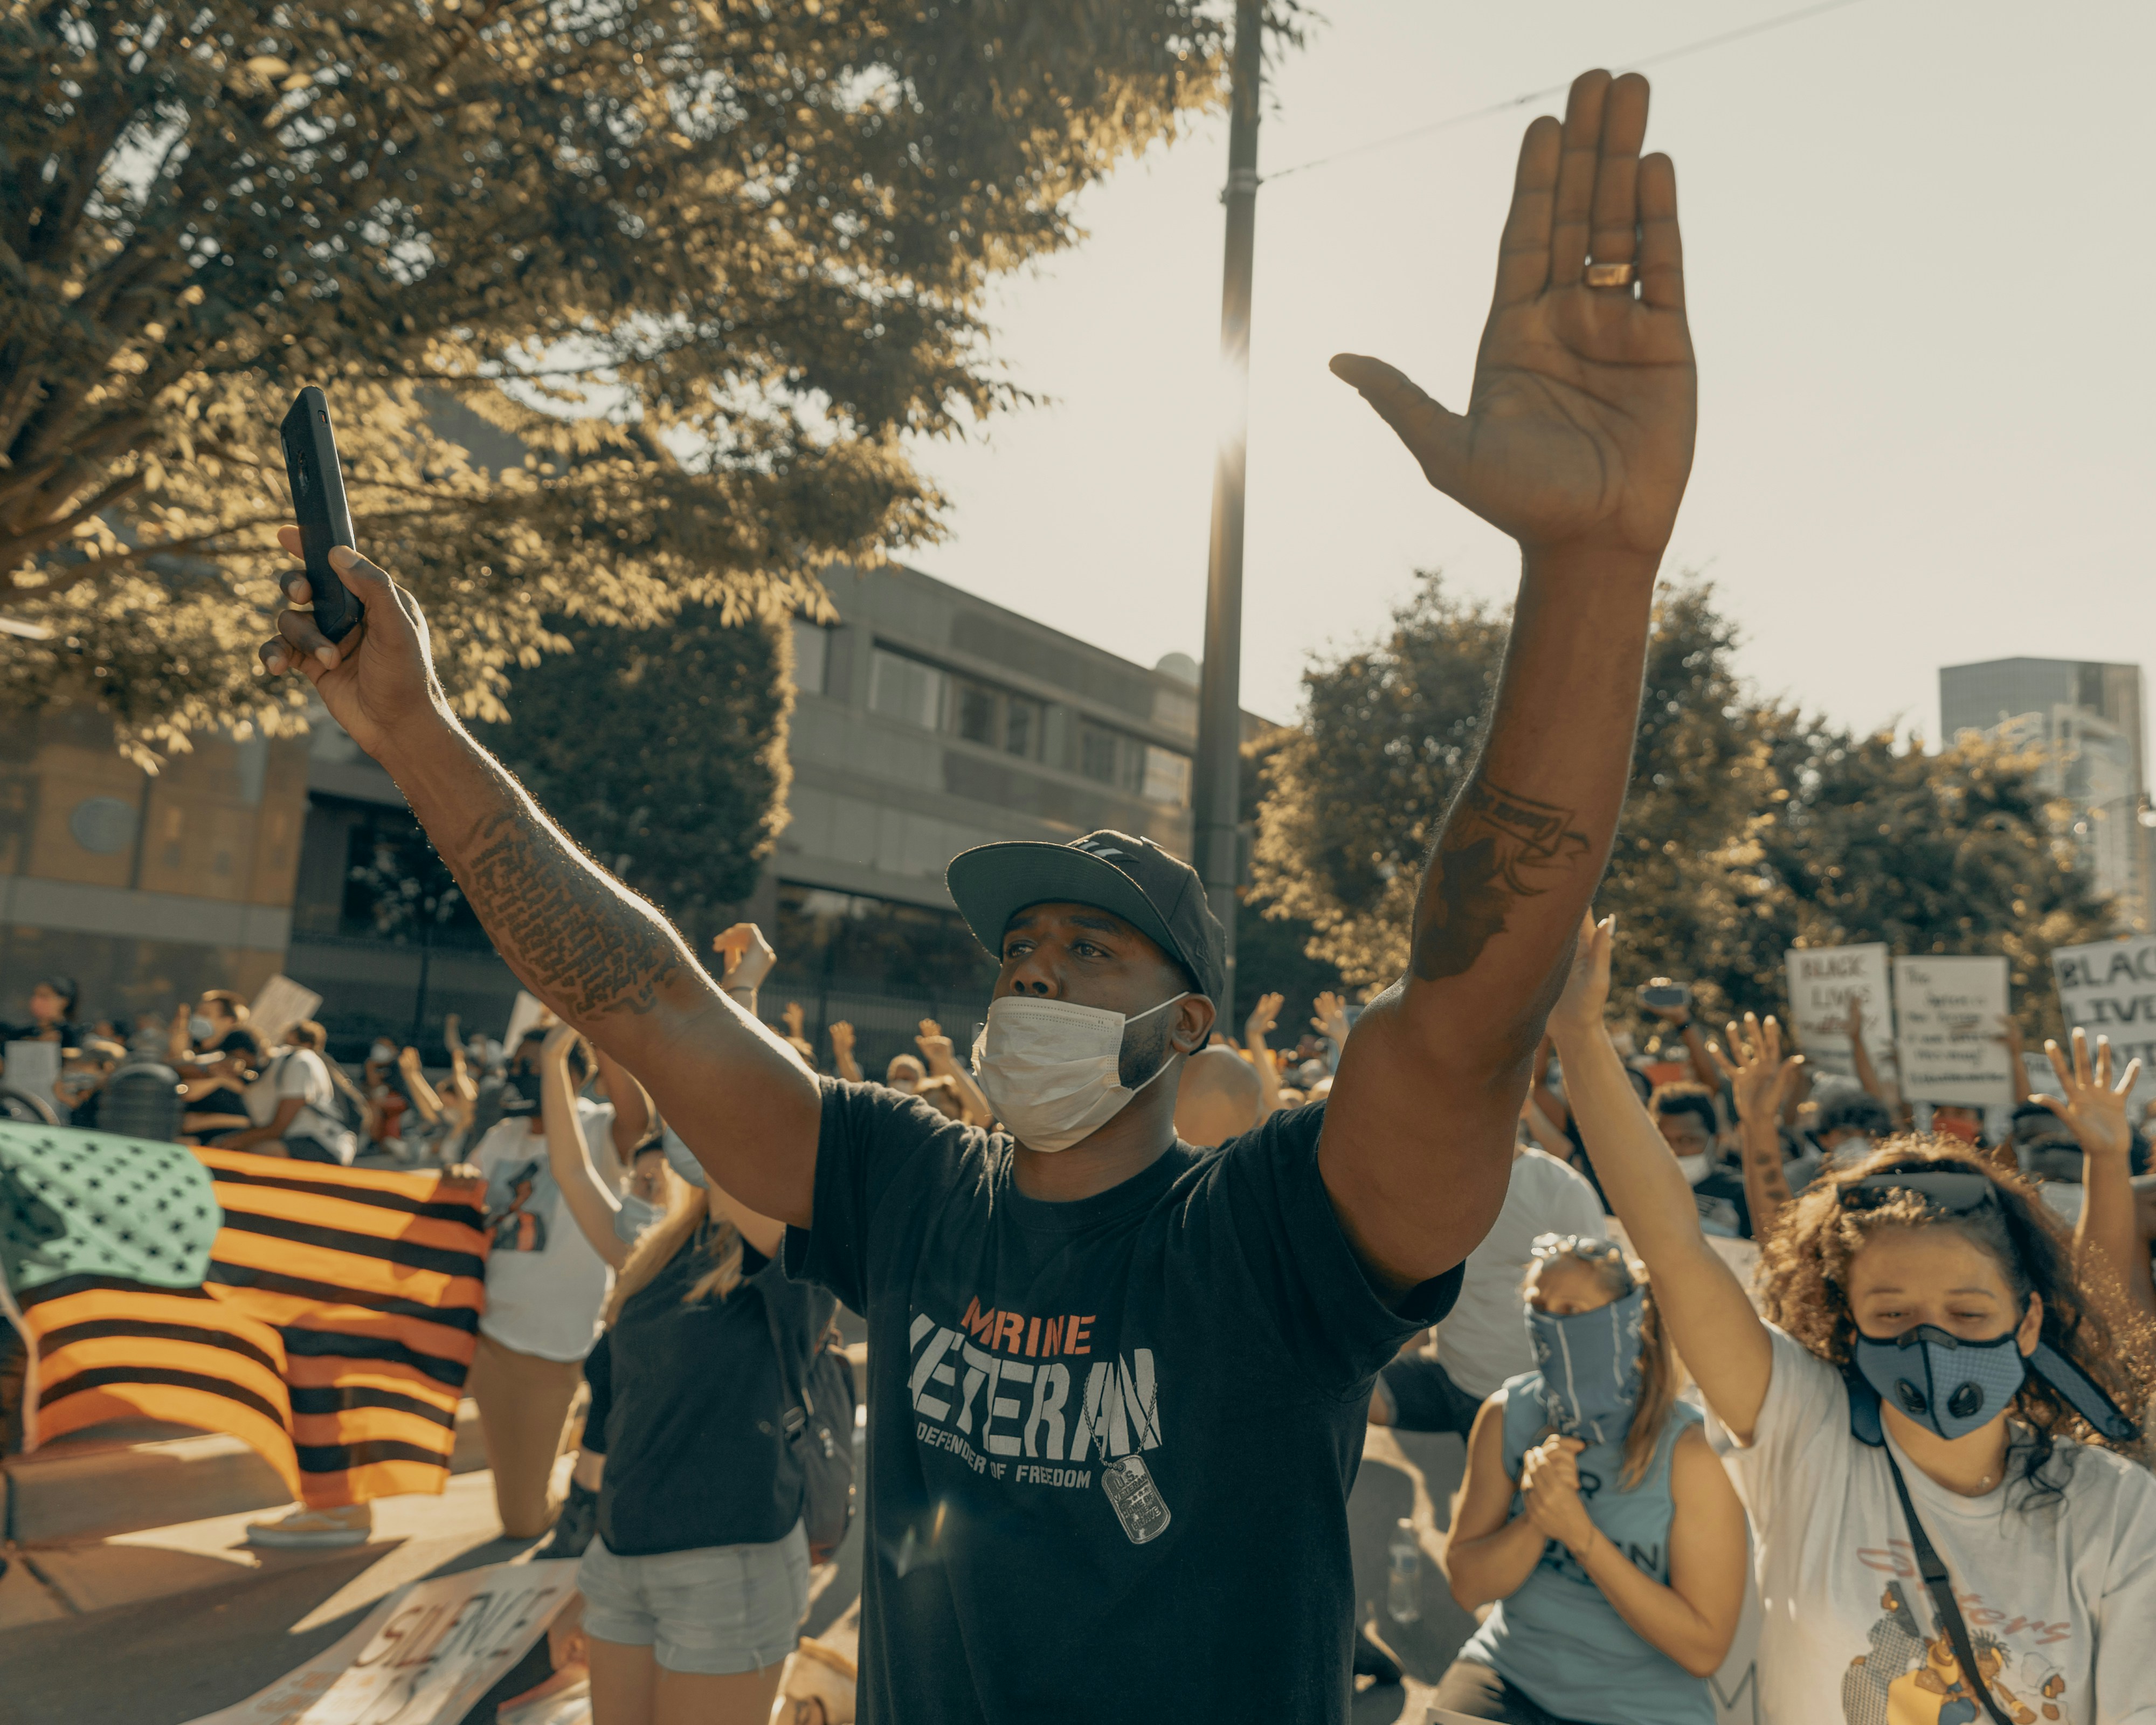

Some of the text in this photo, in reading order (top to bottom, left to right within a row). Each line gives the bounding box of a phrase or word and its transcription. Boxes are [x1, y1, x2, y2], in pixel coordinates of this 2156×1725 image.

[960, 1294, 1096, 1357] MRINE
[917, 1422, 1091, 1489] DEFENDER OF FREEDOM
[1112, 1473, 1148, 1501] VETERAN
[1131, 1506, 1162, 1530] BRAVE
